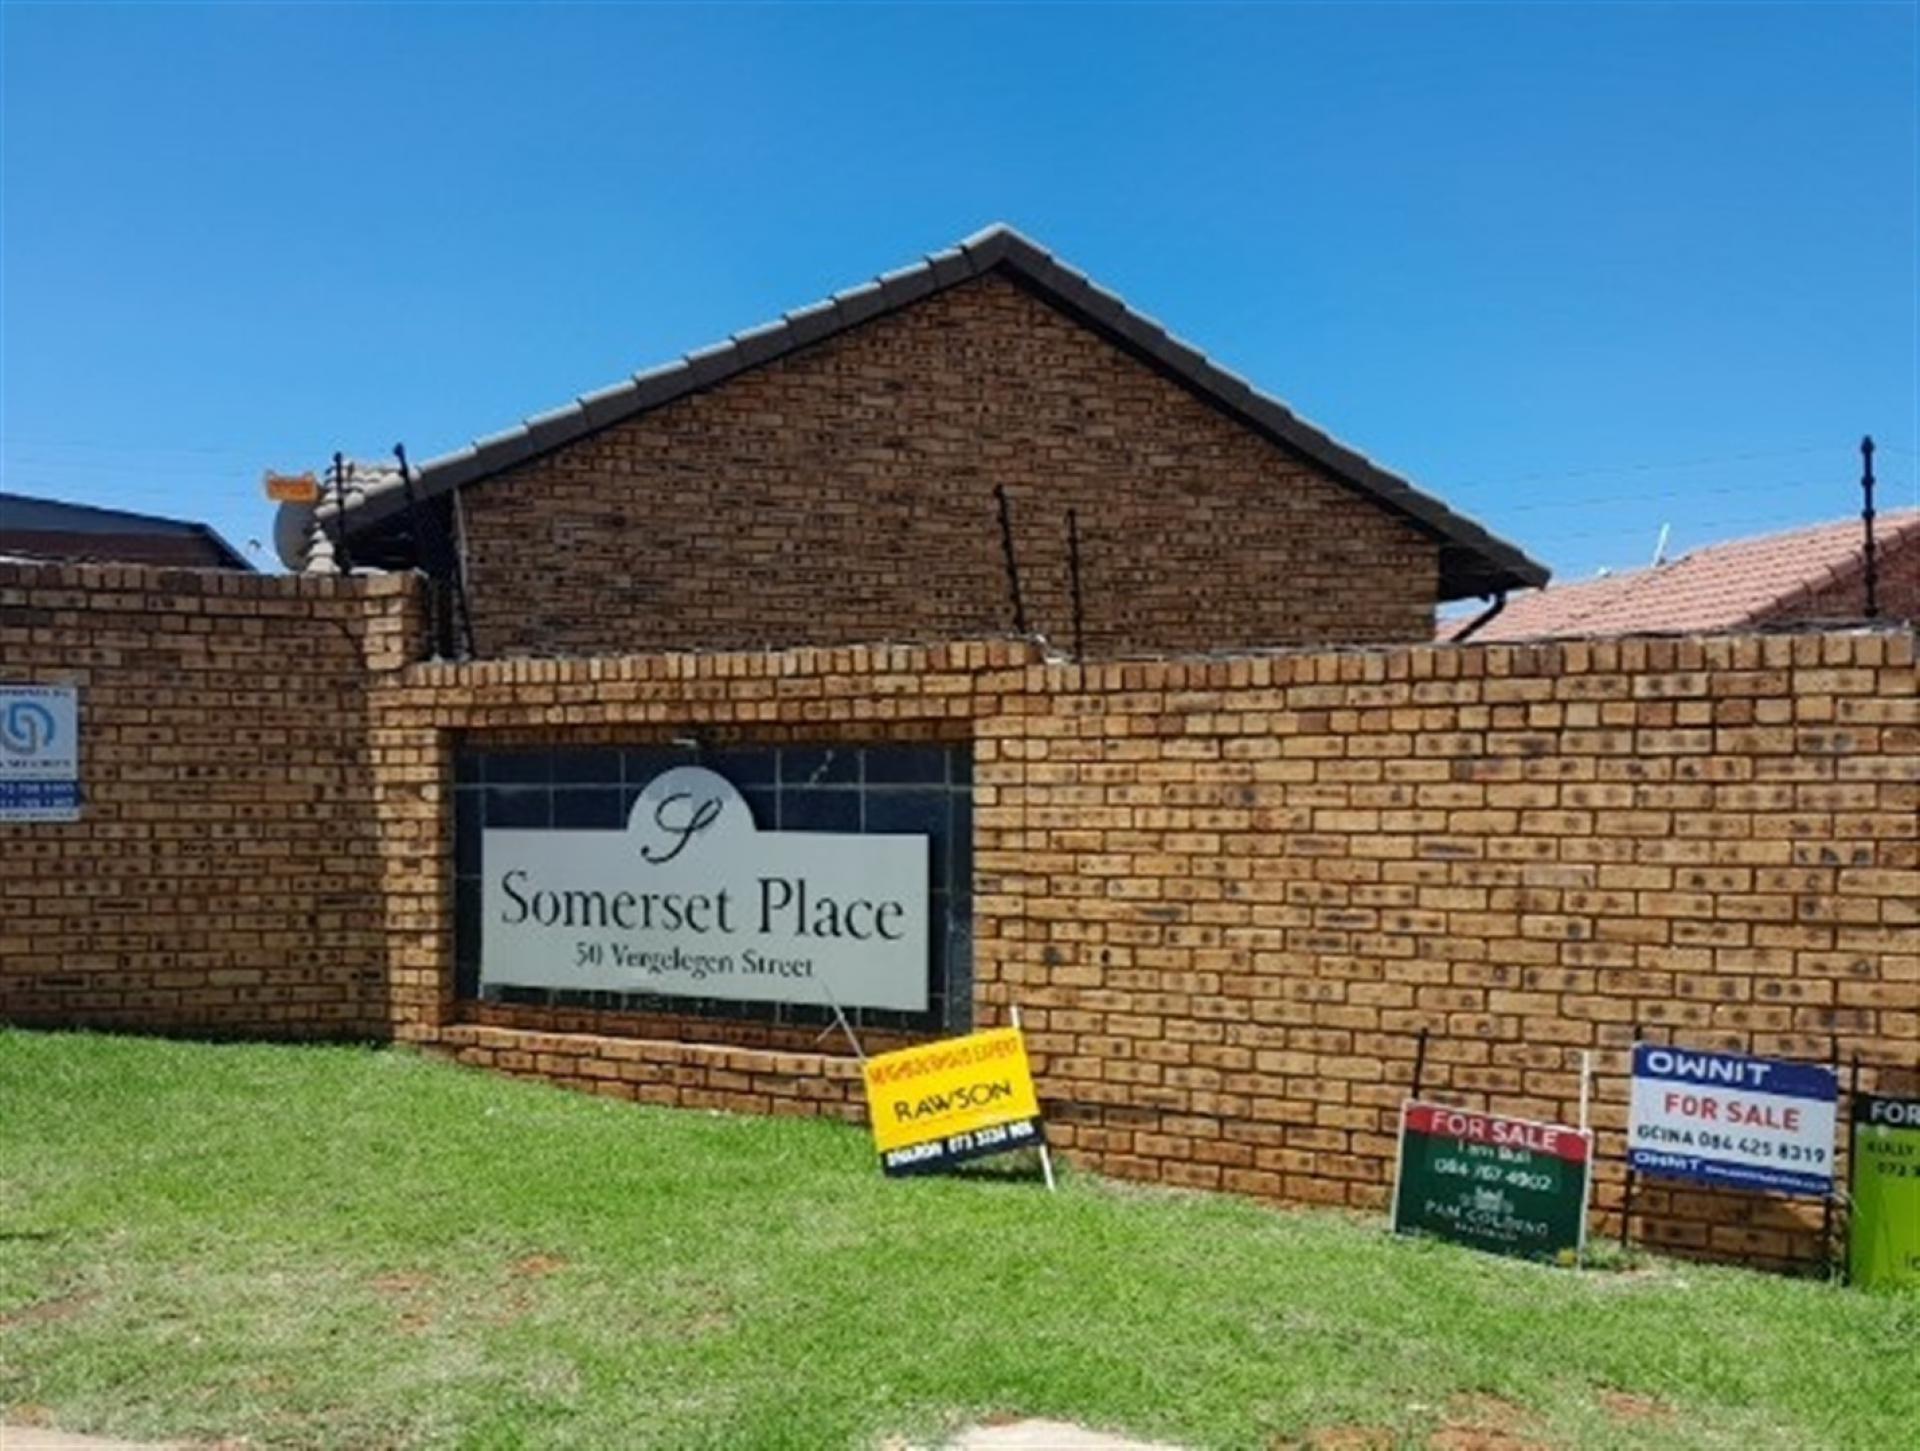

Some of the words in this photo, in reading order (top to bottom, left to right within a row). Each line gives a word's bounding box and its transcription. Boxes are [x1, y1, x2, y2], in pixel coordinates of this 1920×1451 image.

[501, 869, 735, 934] Somerset
[757, 877, 905, 941] Place
[575, 941, 602, 967] 50
[610, 942, 735, 979] Vergelegen
[741, 948, 815, 977] Street
[1646, 1050, 1772, 1086] OWNIT
[893, 1080, 1012, 1124] RAWSON
[1664, 1092, 1719, 1121] FOR
[1726, 1101, 1801, 1132] SALE
[1870, 1102, 1920, 1125] FOR
[1430, 1111, 1486, 1139] FOR
[1491, 1120, 1559, 1153] SALE
[1637, 1124, 1695, 1147] GCINA
[1698, 1131, 1735, 1151] 084
[1738, 1136, 1774, 1157] 425
[1778, 1143, 1827, 1164] 8319
